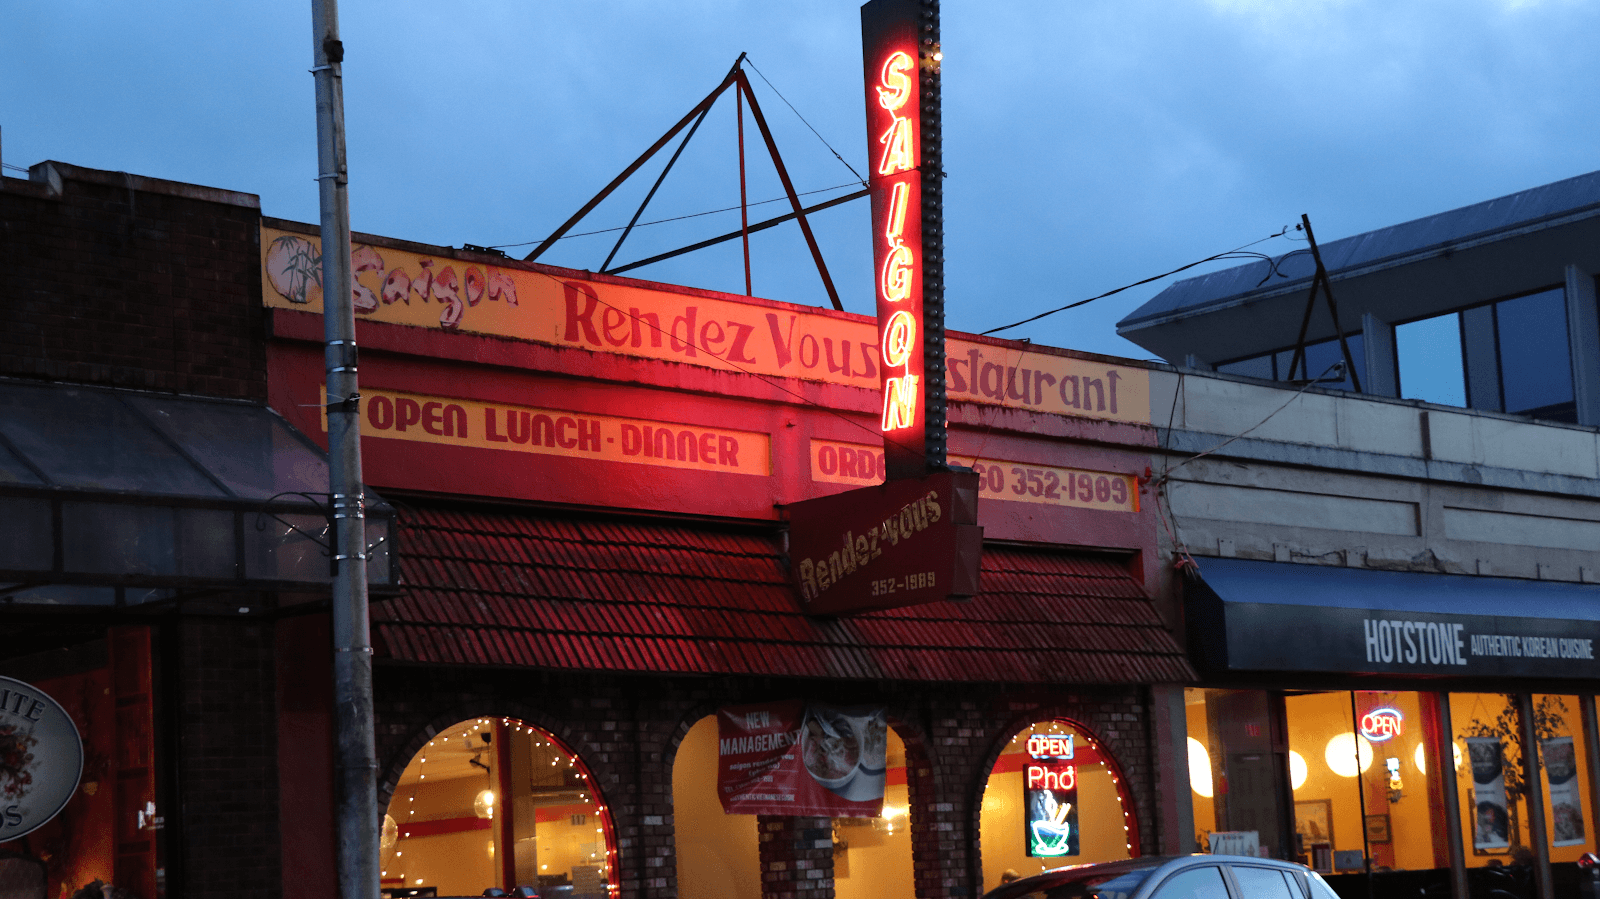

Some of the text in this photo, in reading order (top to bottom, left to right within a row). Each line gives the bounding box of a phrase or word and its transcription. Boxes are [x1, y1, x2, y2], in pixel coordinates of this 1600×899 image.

[877, 50, 917, 431] SAIGON
[351, 246, 519, 329] Saigon
[563, 281, 1123, 415] Rendez Vous staurant
[367, 396, 468, 439] OPEN
[485, 407, 601, 452] LUNCH
[620, 423, 739, 467] DINNER
[871, 571, 936, 597] 352-1989
[1363, 618, 1595, 665] HOTSTONE AUTHENTIC KOREAN CUISINE
[746, 711, 770, 729] NEW
[1361, 714, 1401, 735] OPEN
[720, 729, 801, 756] MANAGEMENT
[1027, 738, 1071, 756] OPEN
